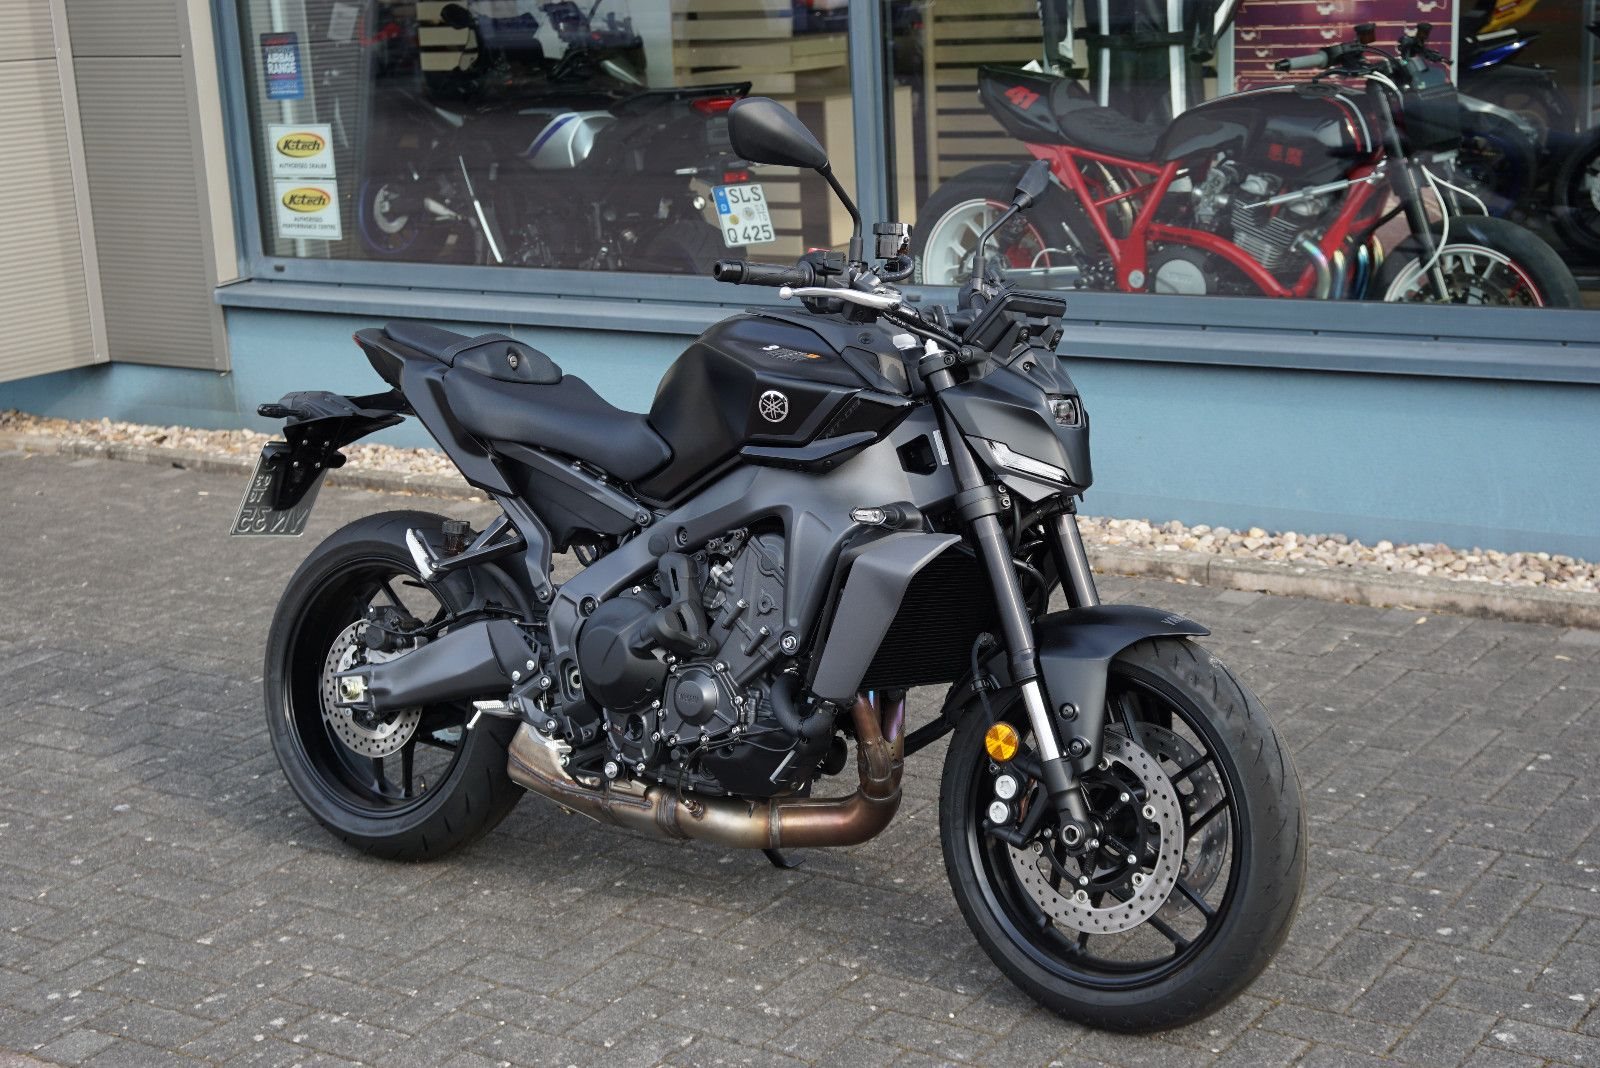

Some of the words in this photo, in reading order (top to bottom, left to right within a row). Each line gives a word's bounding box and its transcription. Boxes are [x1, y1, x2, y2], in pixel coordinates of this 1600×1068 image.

[267, 62, 297, 75] RANGE
[729, 186, 761, 204] SLS
[727, 228, 738, 244] Q
[743, 225, 772, 242] 425
